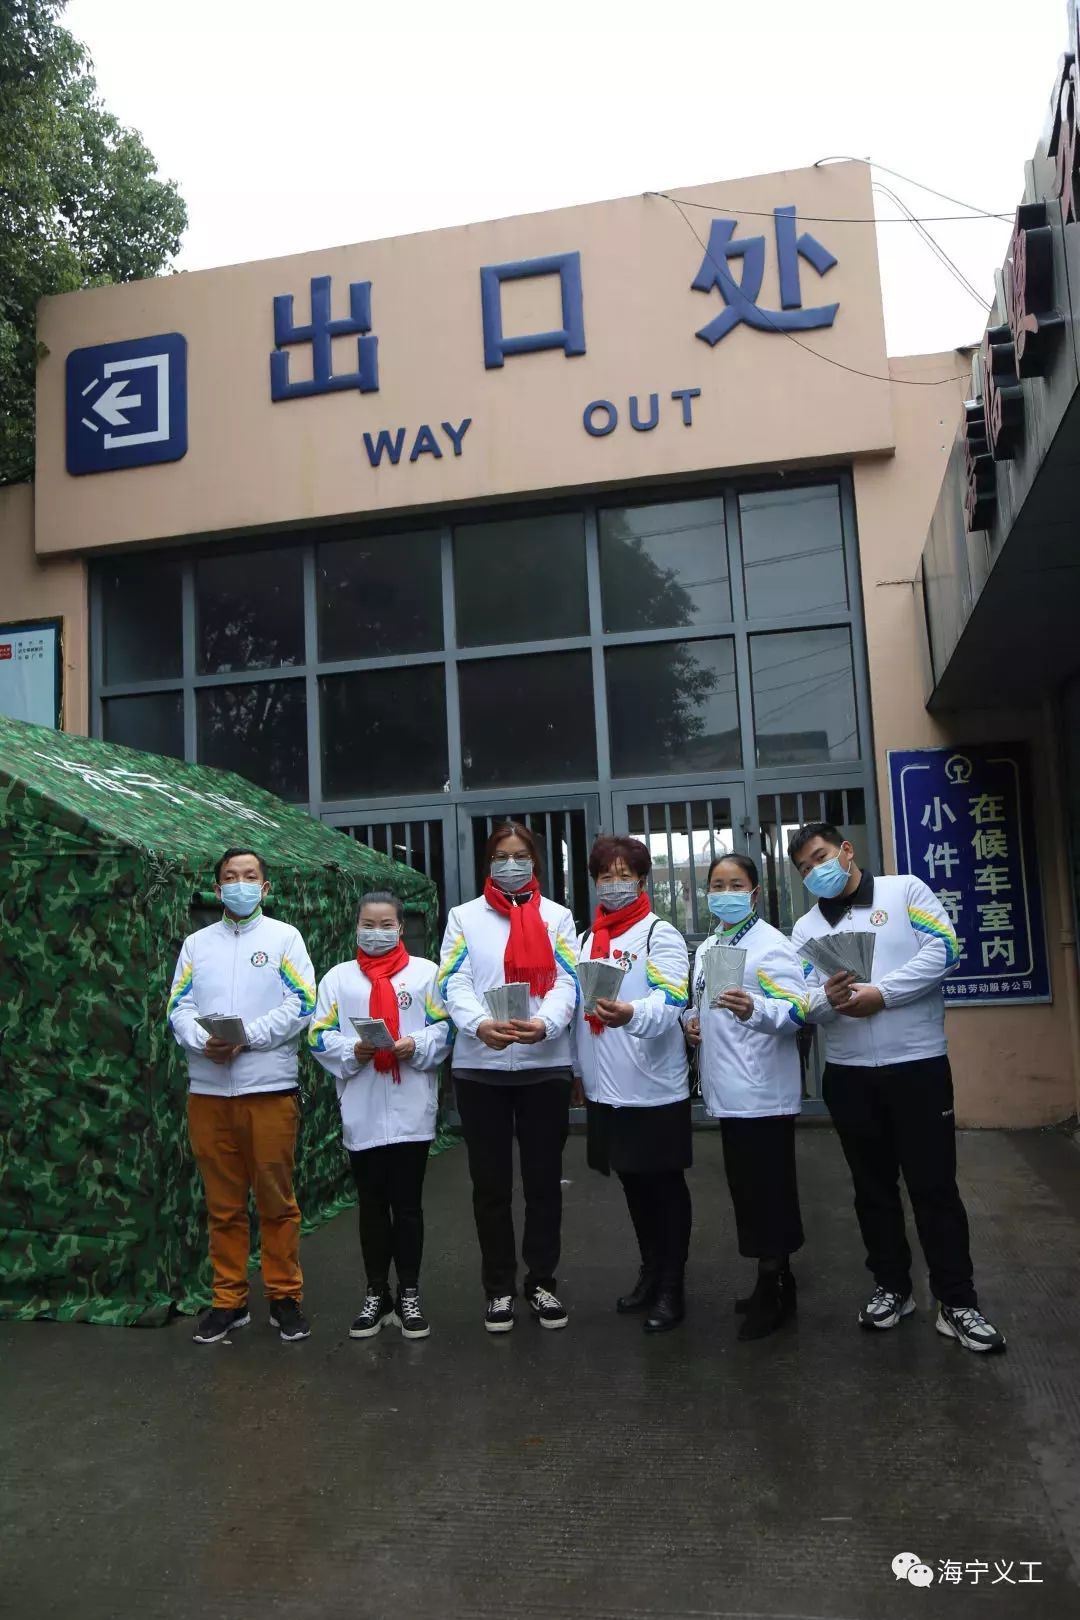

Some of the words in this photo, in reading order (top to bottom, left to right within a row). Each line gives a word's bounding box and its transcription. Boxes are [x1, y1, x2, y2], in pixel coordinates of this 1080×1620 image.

[270, 204, 840, 402] 出口处
[362, 418, 472, 467] WAY
[583, 388, 702, 436] OUT
[968, 793, 1016, 968] 在候车室内
